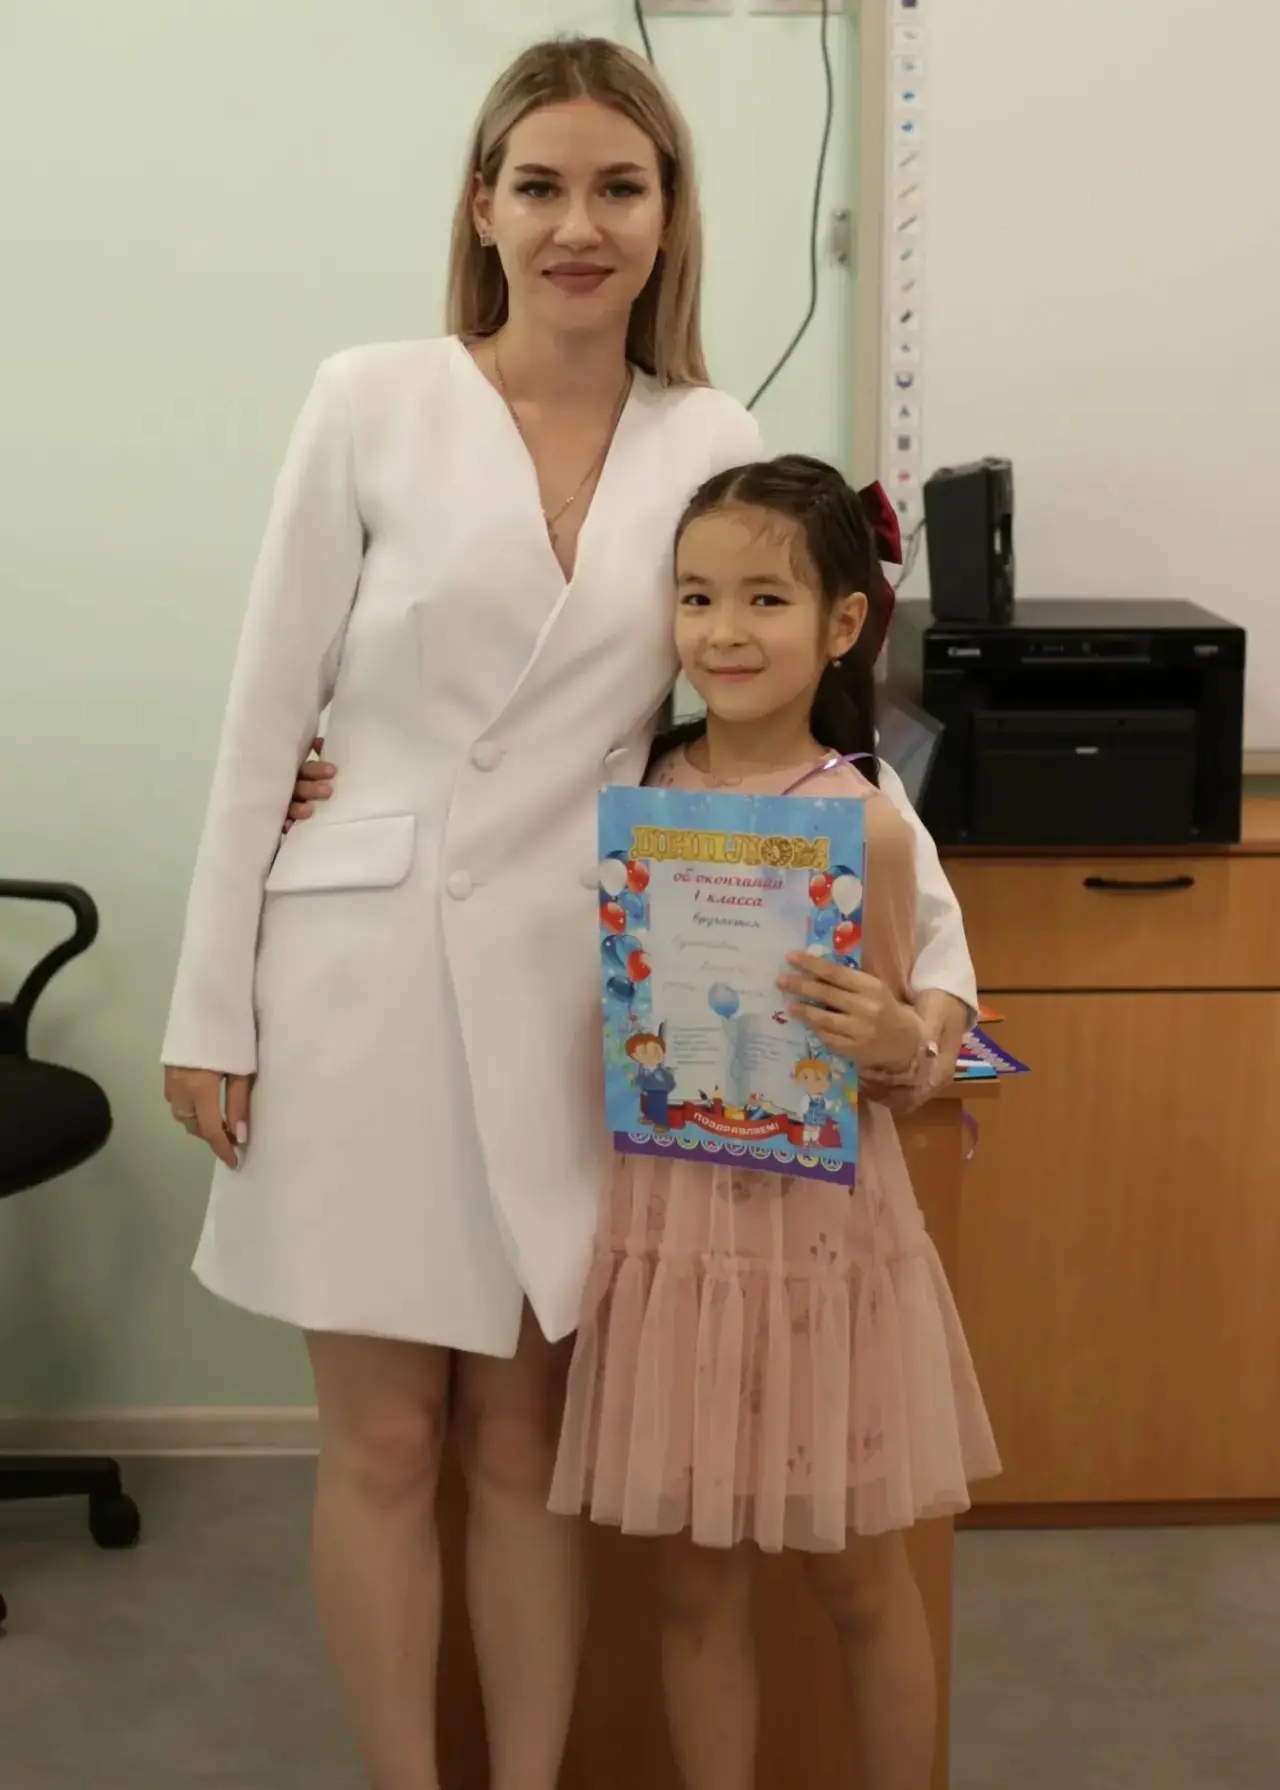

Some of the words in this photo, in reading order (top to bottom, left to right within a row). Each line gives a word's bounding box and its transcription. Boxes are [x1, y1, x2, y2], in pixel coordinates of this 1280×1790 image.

[630, 826, 831, 869] ДИПЛОМ
[672, 867, 693, 883] об
[695, 873, 784, 890] окончании
[706, 894, 764, 907] класса
